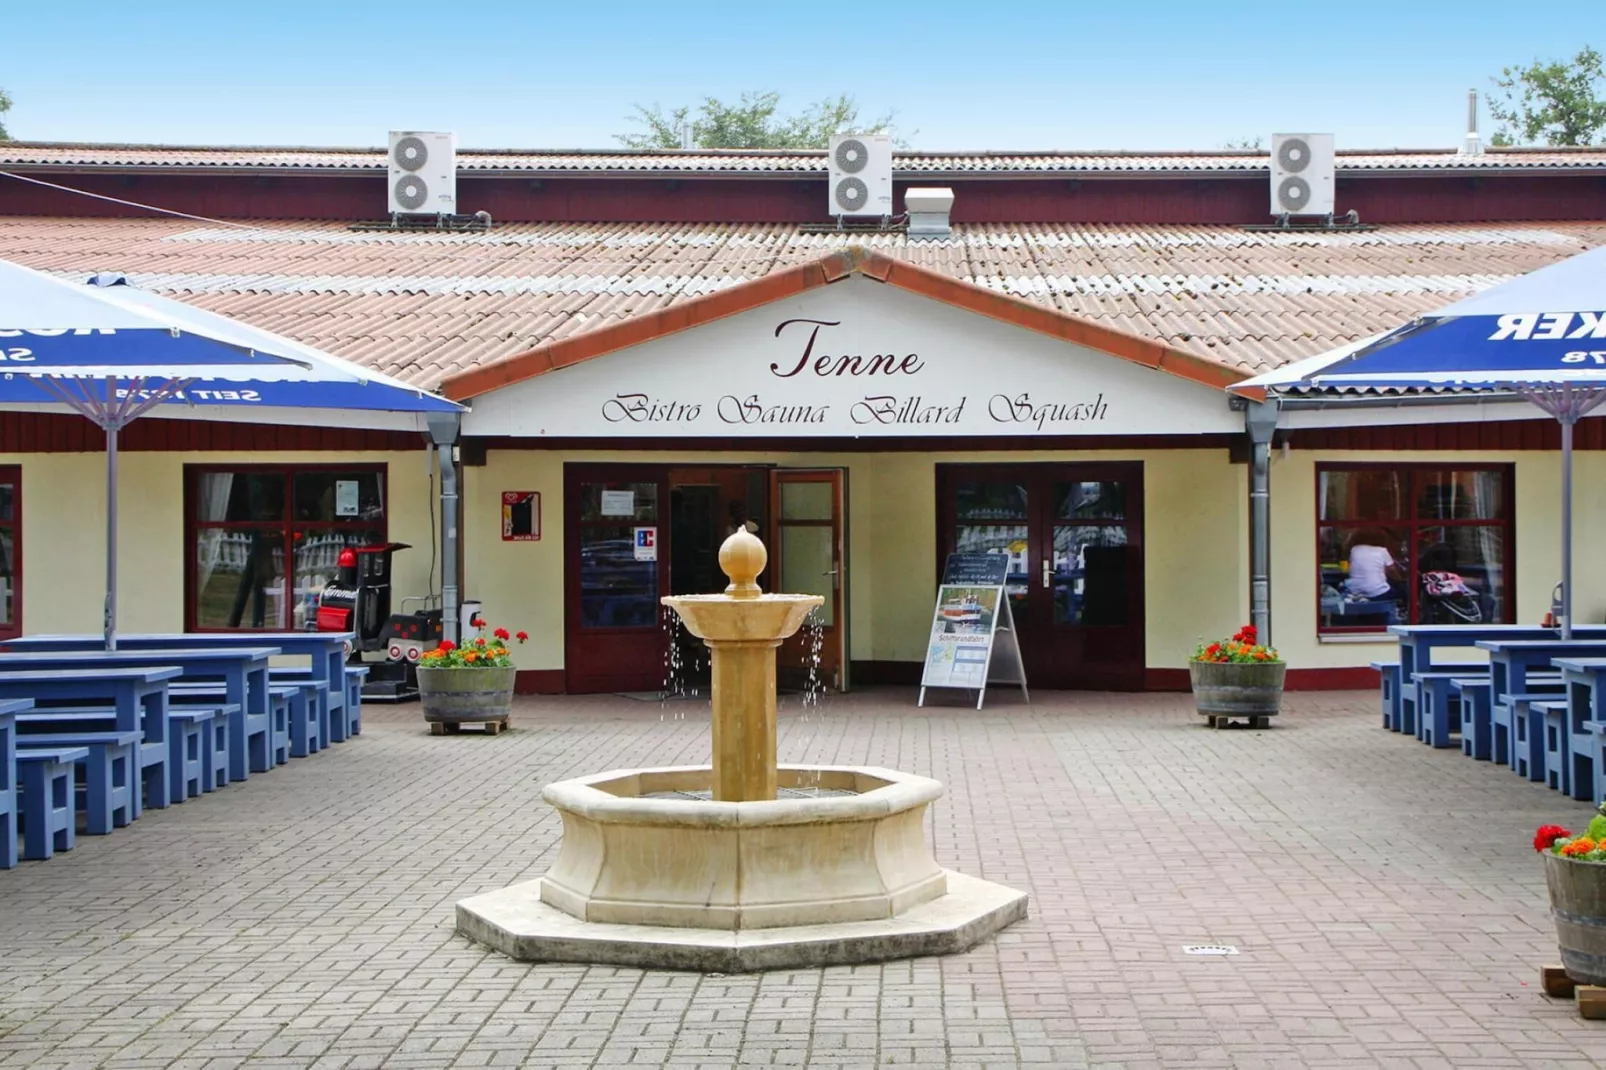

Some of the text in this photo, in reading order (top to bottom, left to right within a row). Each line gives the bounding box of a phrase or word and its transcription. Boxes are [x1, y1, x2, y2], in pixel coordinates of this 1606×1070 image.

[770, 319, 925, 377] Tenne
[602, 393, 1108, 431] Bistro Sauna Billard Squash
